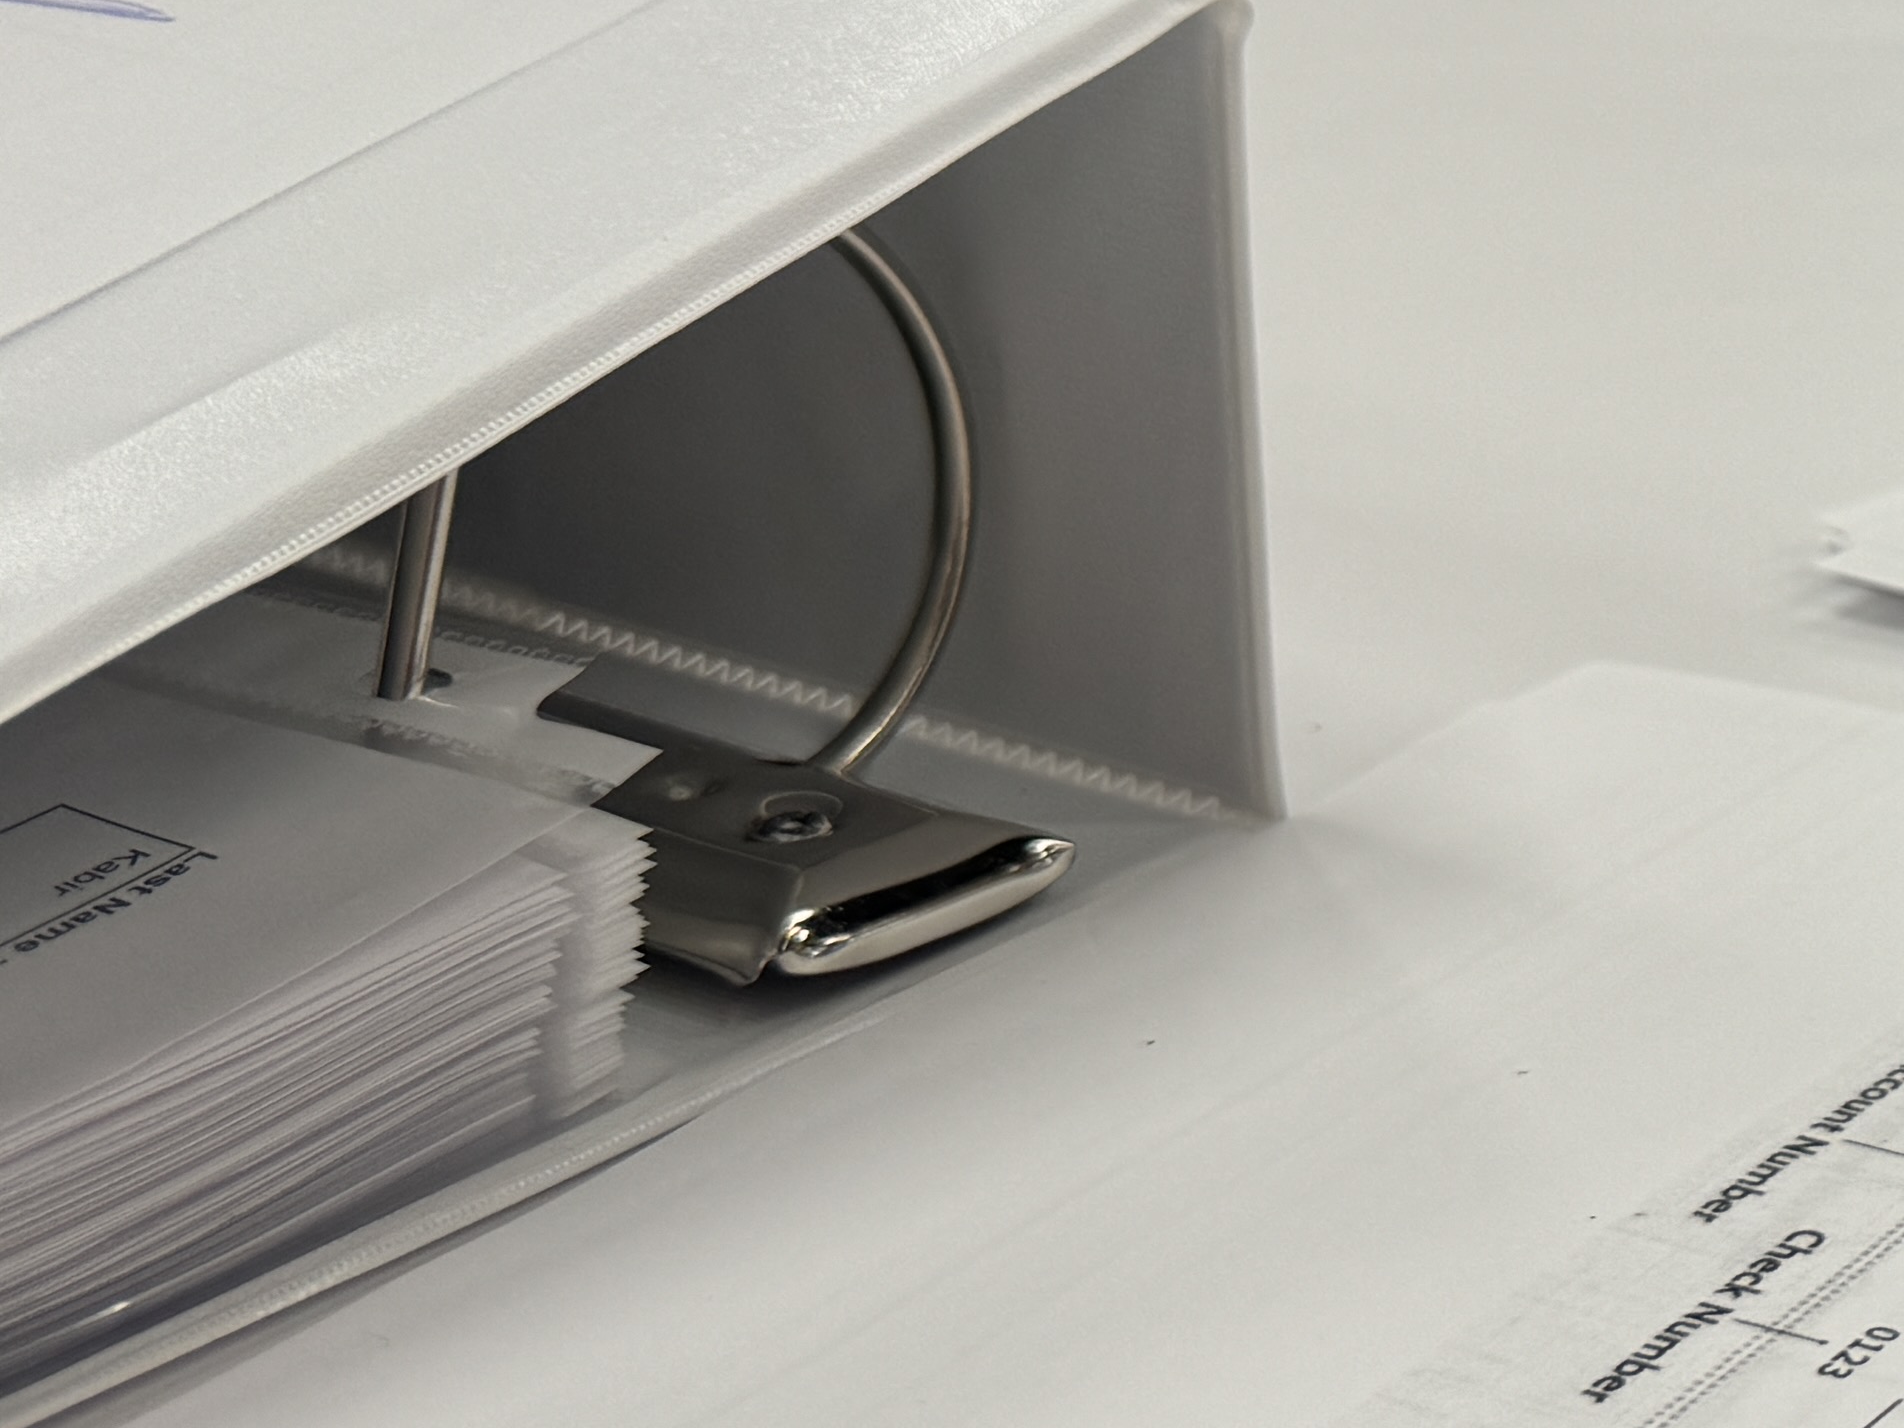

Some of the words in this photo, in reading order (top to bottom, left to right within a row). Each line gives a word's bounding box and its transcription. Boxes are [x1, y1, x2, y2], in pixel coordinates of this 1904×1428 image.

[53, 848, 151, 897] Kabir
[128, 850, 218, 896] Last
[13, 896, 131, 952] Name
[1694, 1135, 1832, 1223] Number
[1715, 1229, 1826, 1298] Check
[1580, 1300, 1733, 1402] Number
[1817, 1325, 1901, 1380] 0123
